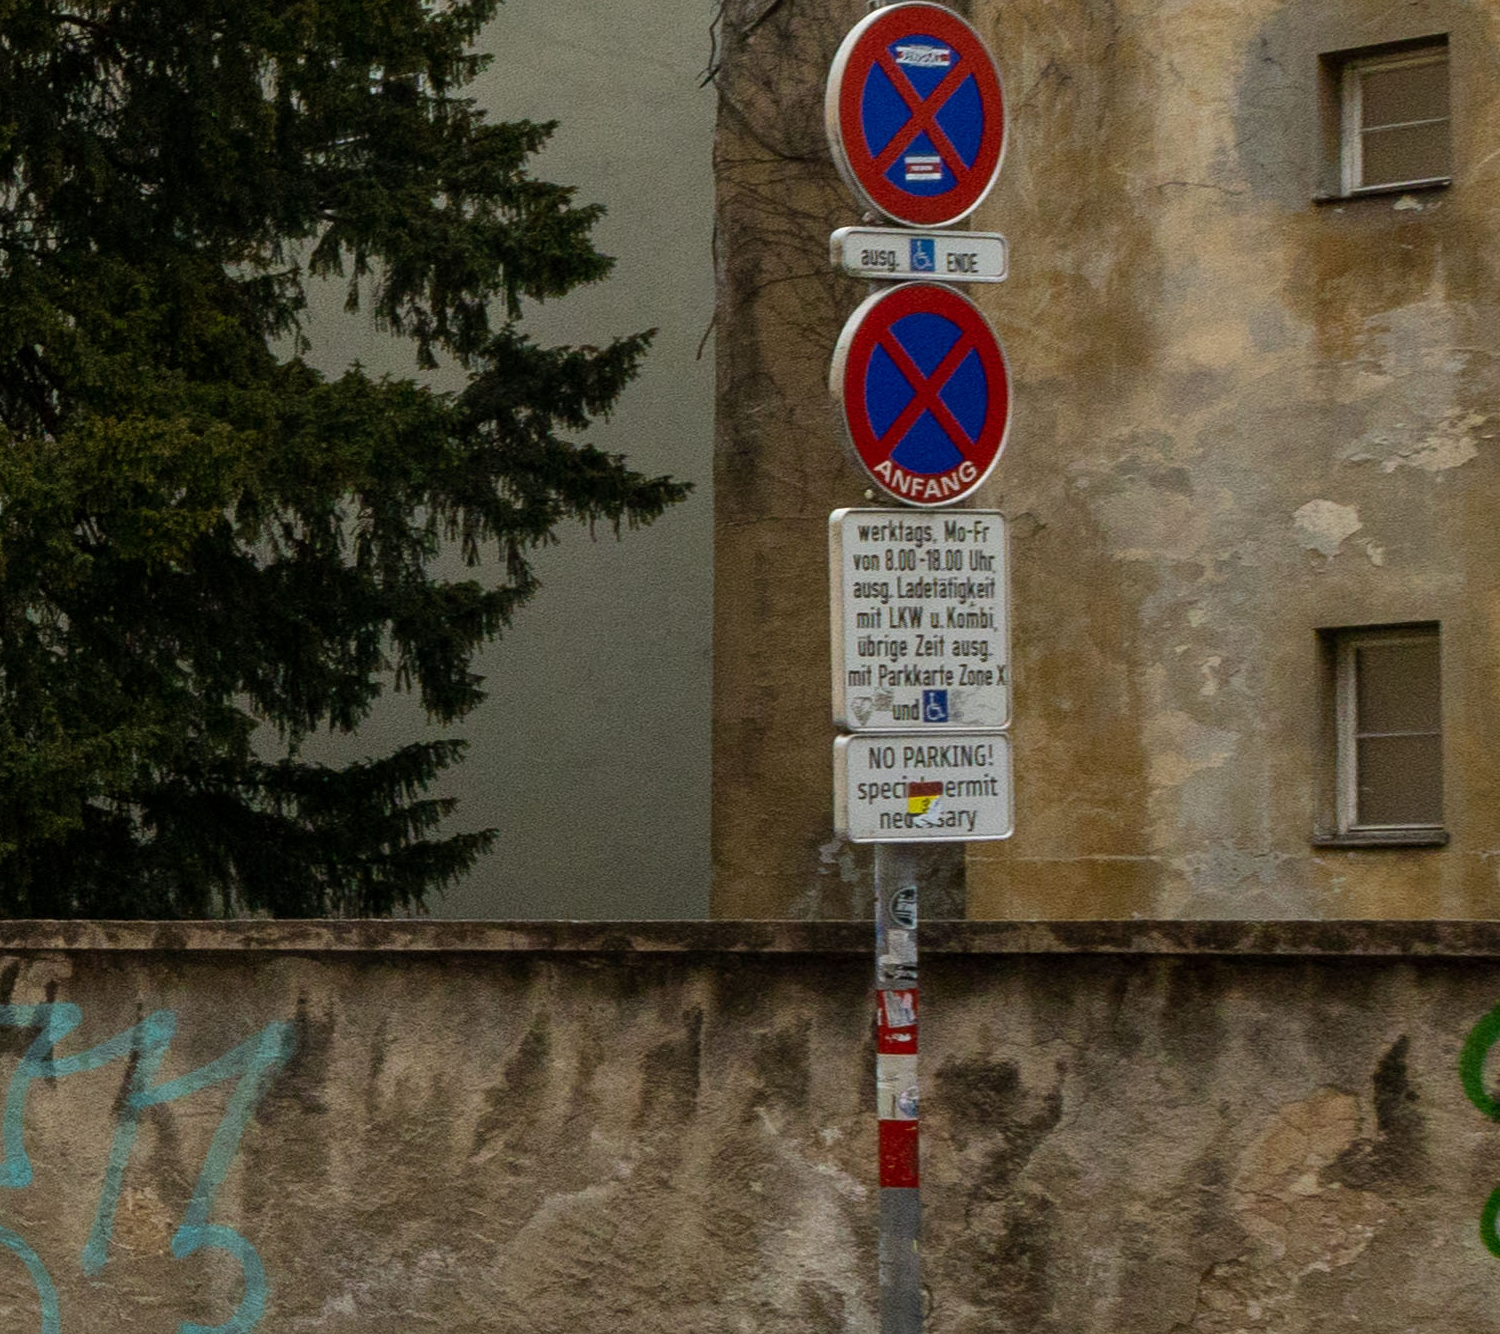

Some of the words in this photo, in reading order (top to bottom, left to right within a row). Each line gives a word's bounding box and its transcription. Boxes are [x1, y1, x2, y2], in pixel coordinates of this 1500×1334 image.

[861, 249, 900, 273] ausg.
[947, 252, 979, 273] ENDE
[873, 460, 977, 498] ANFANG
[944, 520, 990, 542] Mo-Fr
[853, 554, 880, 571] von
[853, 581, 893, 605] ausg.
[897, 576, 995, 604] Ladetätigkeit
[856, 607, 882, 629] mit
[889, 606, 923, 629] LKW
[857, 635, 908, 663] übrige
[915, 634, 945, 657] Zeit
[952, 640, 994, 663] ausg.
[848, 665, 872, 687] mit
[878, 664, 954, 687] Parkkarte
[959, 664, 993, 686] Zone
[892, 699, 920, 720] und
[869, 746, 896, 769] NO
[903, 744, 994, 768] PARKING!
